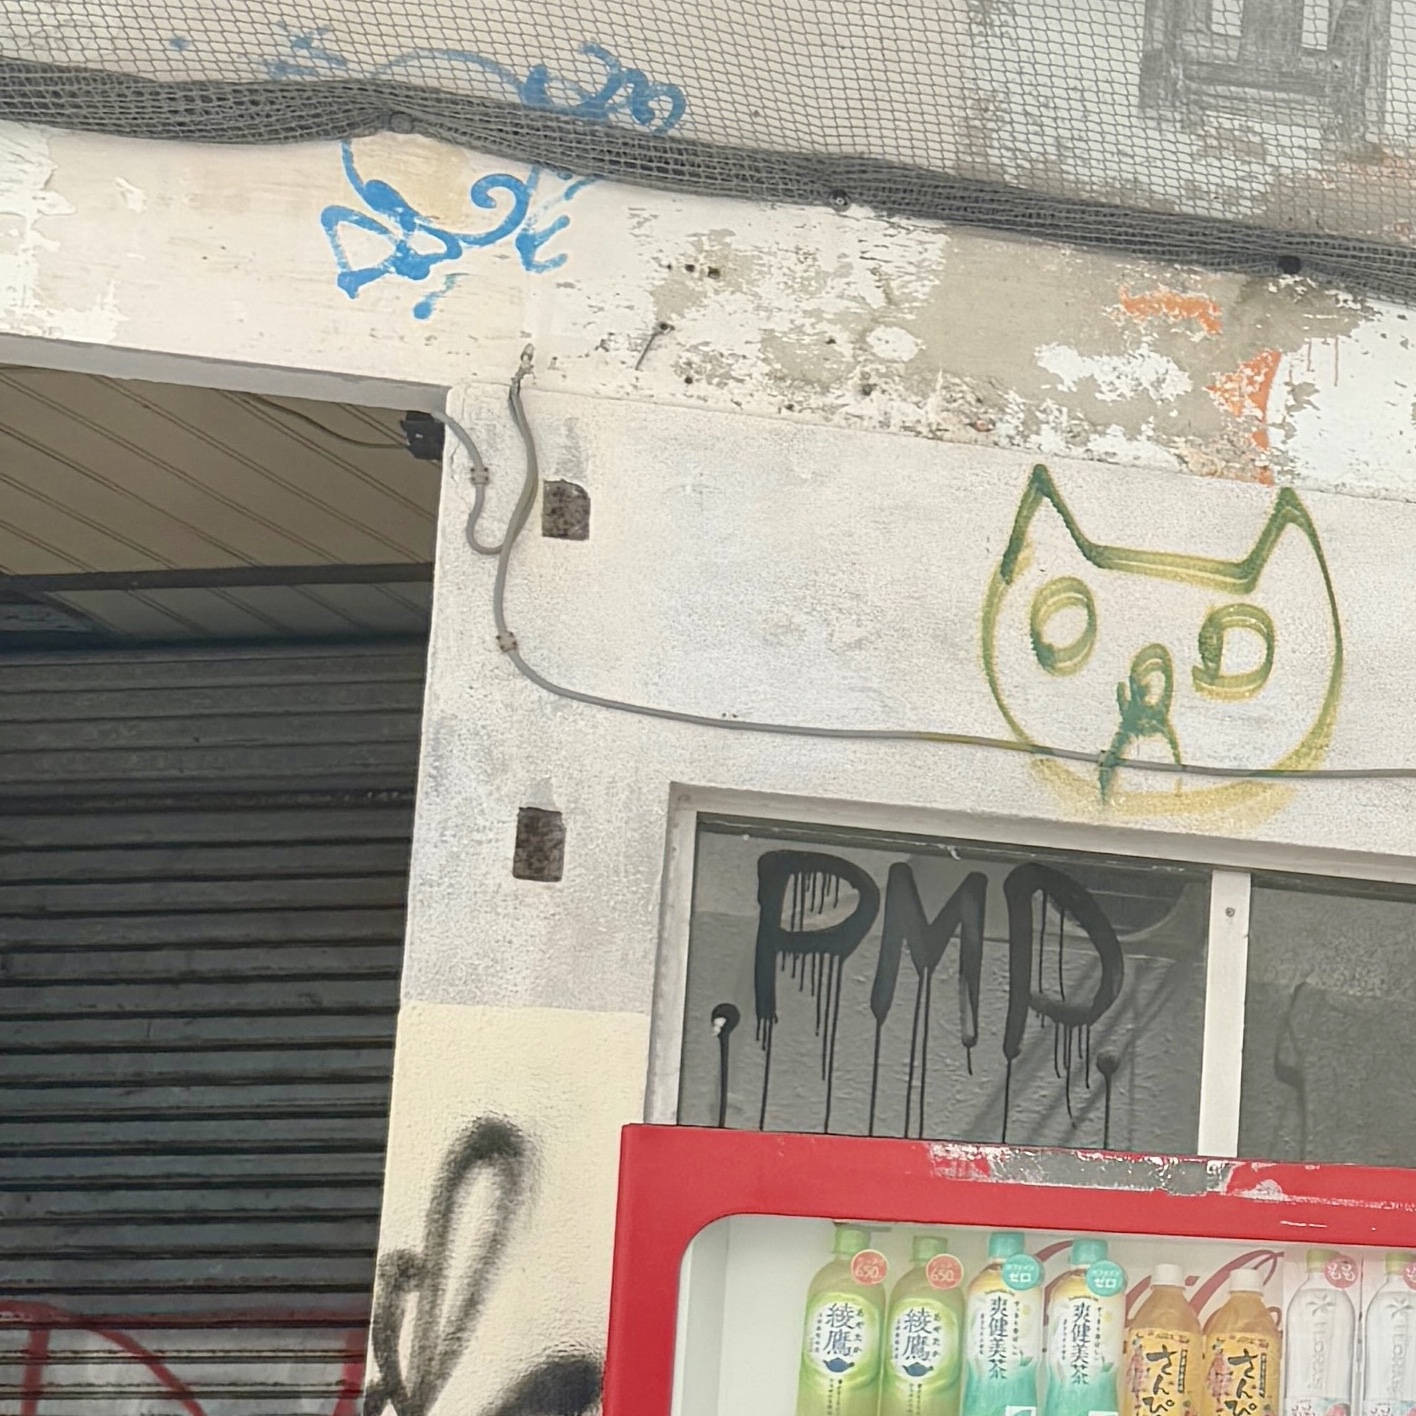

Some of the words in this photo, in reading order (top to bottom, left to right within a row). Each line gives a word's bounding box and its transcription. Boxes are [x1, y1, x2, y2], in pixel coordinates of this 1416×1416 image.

[754, 848, 1125, 1060] PMD
[1009, 1273, 1032, 1283] ゼロ
[1094, 1278, 1117, 1288] ゼロ
[823, 1303, 855, 1356] 綾鷹
[903, 1308, 932, 1361] 綾鷹
[988, 1297, 1009, 1379] 爽健美茶
[1071, 1302, 1091, 1385] 爽健美茶
